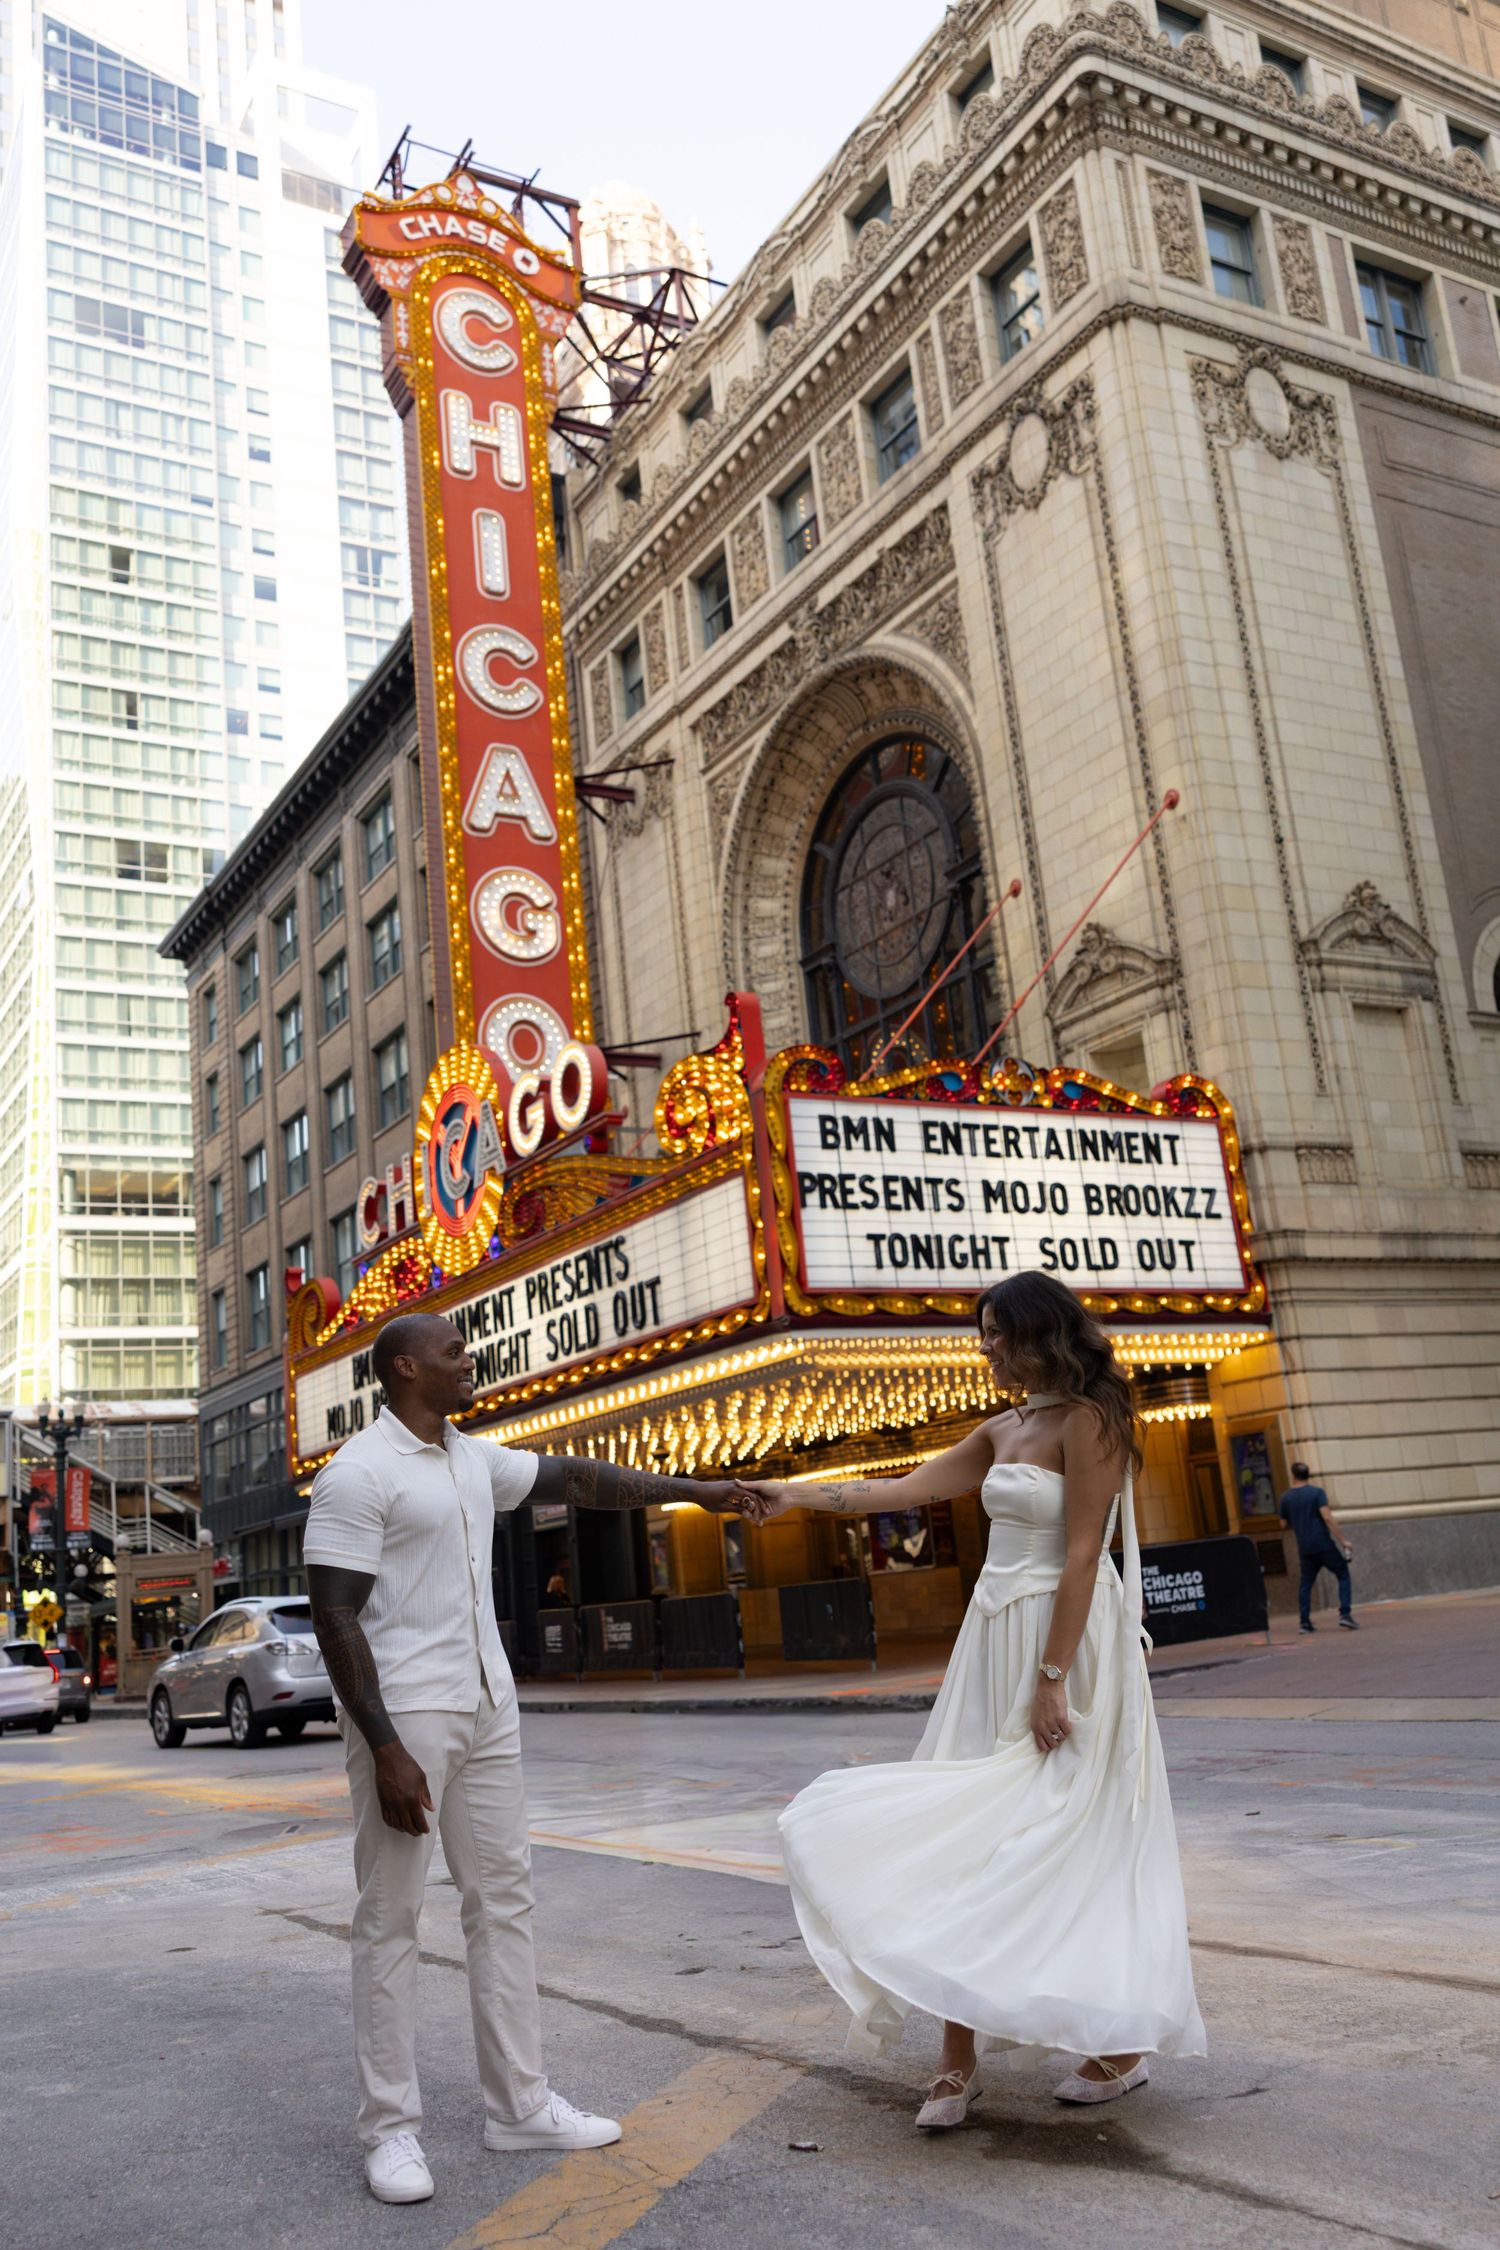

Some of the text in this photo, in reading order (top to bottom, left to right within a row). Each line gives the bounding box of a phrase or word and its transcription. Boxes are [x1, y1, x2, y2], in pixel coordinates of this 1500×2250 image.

[399, 213, 509, 255] CHASE
[433, 286, 568, 1080] CHICAGO
[356, 1040, 593, 1250] CHICAGO
[818, 1114, 1180, 1166] BMN ENTERTAINMENT
[799, 1171, 1223, 1220] PRESENTS MOJO BROOKZZ
[866, 1232, 1196, 1272] TONIGHT SOLD OUT
[525, 1235, 630, 1319] PRESENTS
[327, 1396, 364, 1441] MOJO
[470, 1329, 532, 1390] ONIGHT
[546, 1302, 600, 1361] SOLD
[613, 1275, 662, 1337] OUT
[1142, 1565, 1160, 1576] THE
[1143, 1570, 1203, 1591] CHICAGO
[1145, 1584, 1206, 1605] THEATRE
[1170, 1601, 1197, 1614] CHASE
